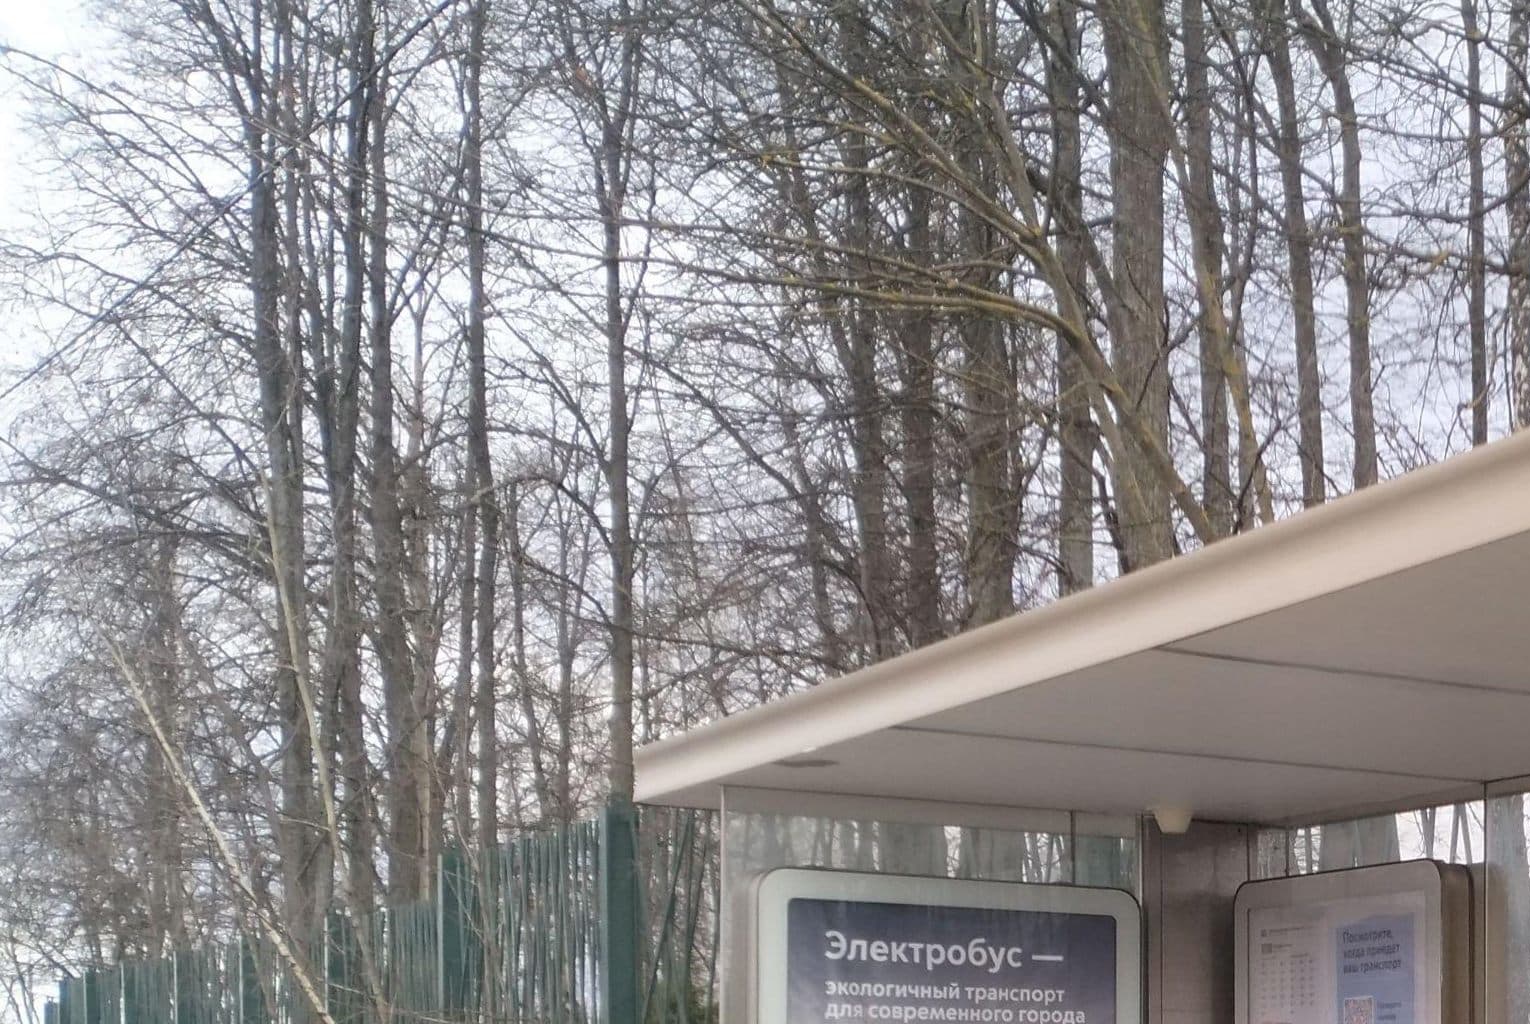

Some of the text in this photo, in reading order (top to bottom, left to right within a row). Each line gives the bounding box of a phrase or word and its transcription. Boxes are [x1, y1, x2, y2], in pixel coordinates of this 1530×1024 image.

[825, 931, 1022, 973] Электробус
[825, 980, 1065, 1005] экологичный транспорт
[825, 1003, 863, 1020] для
[868, 1004, 1013, 1023] современного
